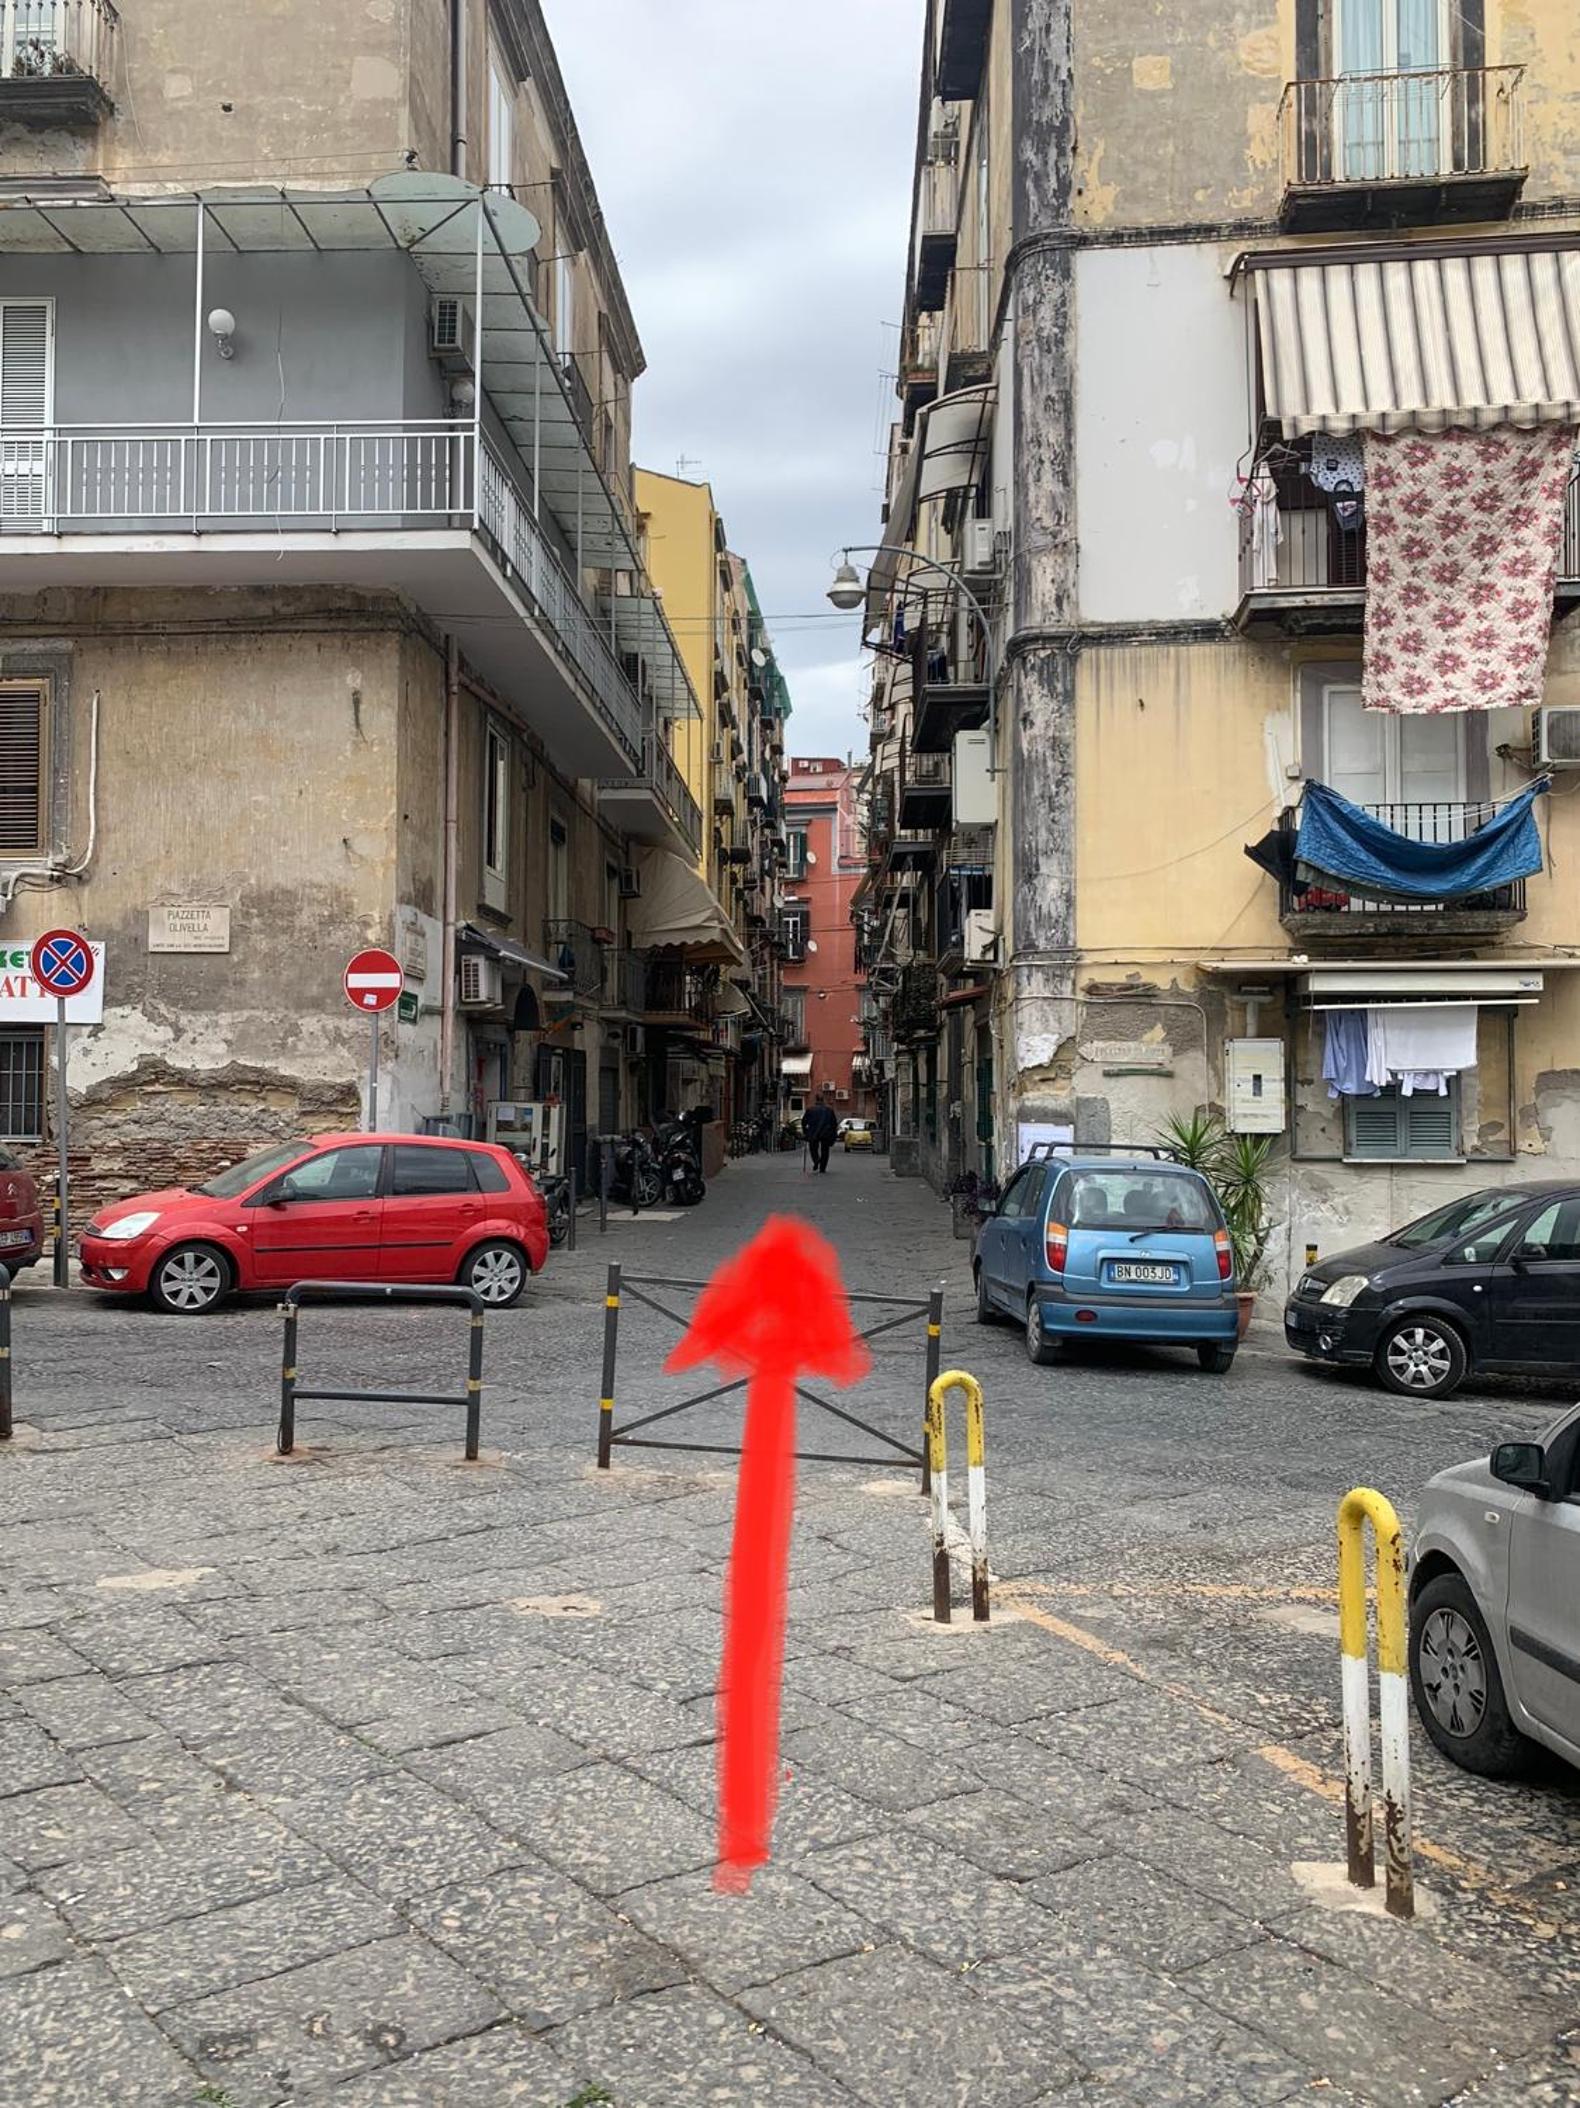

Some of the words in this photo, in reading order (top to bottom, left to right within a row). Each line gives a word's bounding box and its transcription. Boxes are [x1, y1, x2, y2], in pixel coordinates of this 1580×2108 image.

[168, 910, 211, 920] PIAZZETTA
[169, 923, 208, 932] OLIVELLA
[1117, 1265, 1131, 1278] BN
